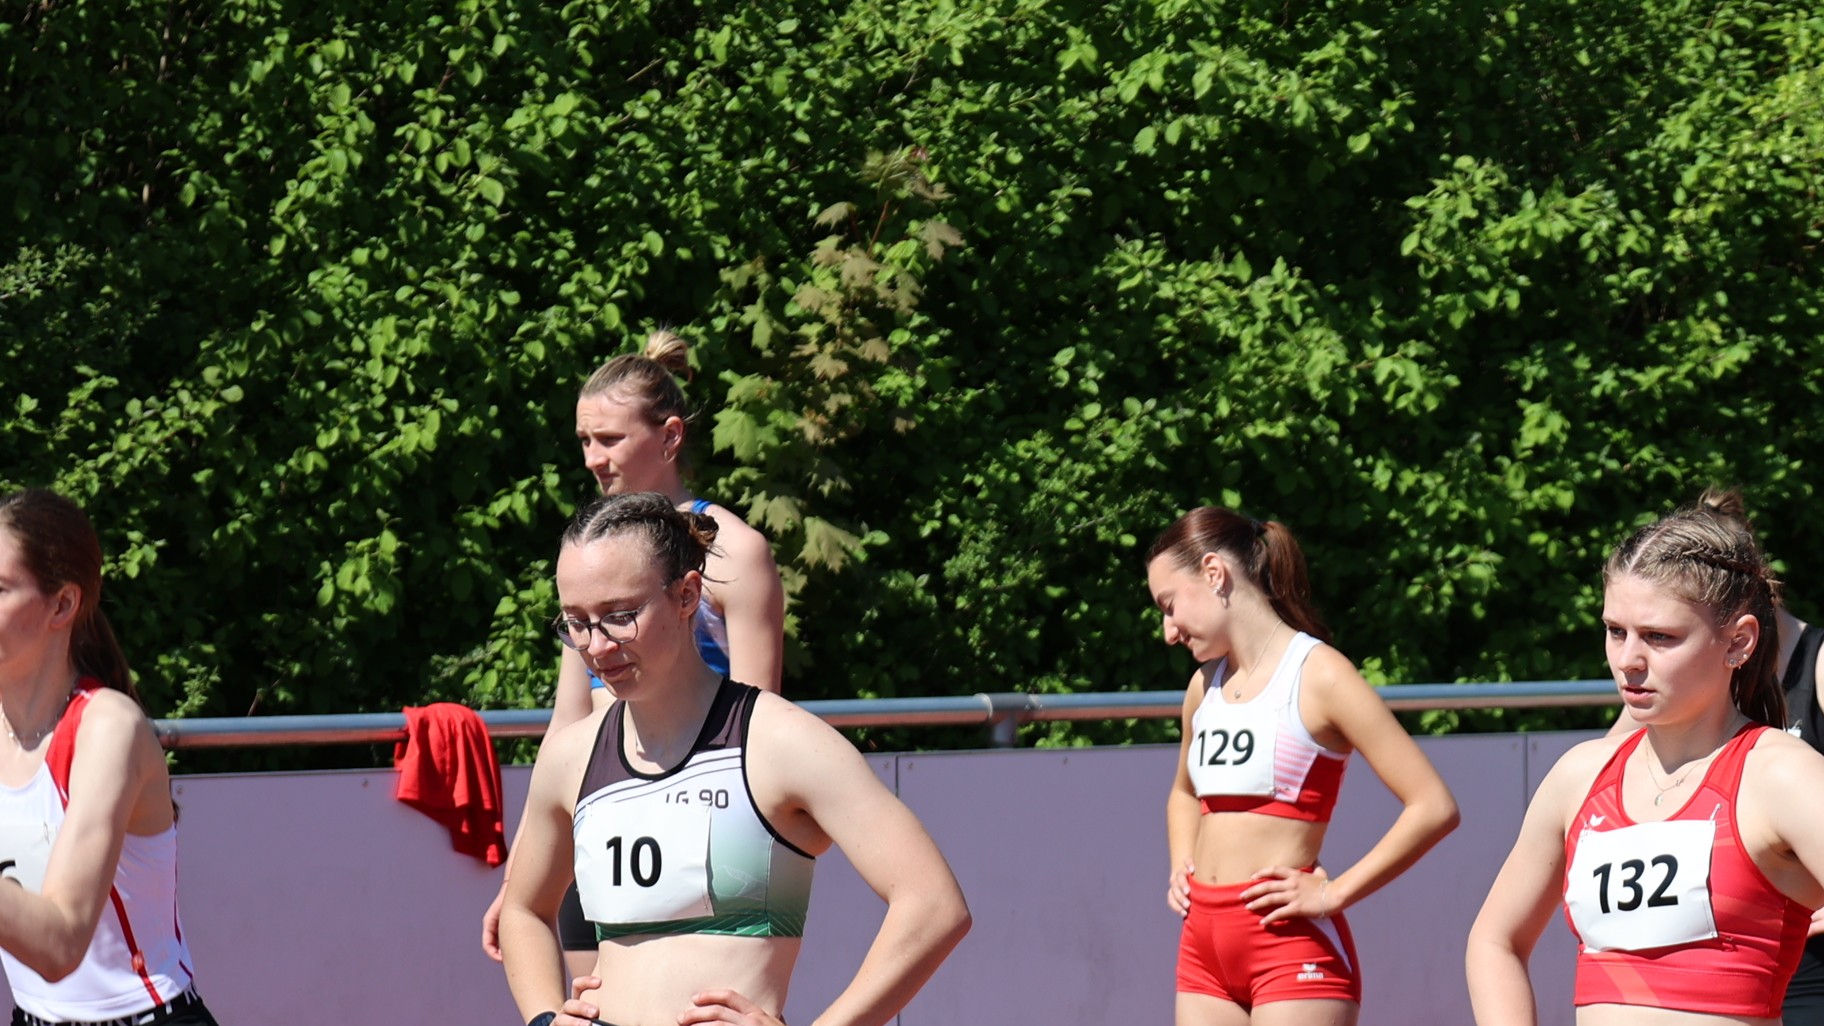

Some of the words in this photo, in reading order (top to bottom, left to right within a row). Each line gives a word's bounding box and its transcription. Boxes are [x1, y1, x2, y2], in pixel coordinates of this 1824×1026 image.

[1198, 728, 1254, 767] 129
[606, 836, 662, 887] 10
[1592, 853, 1679, 914] 132
